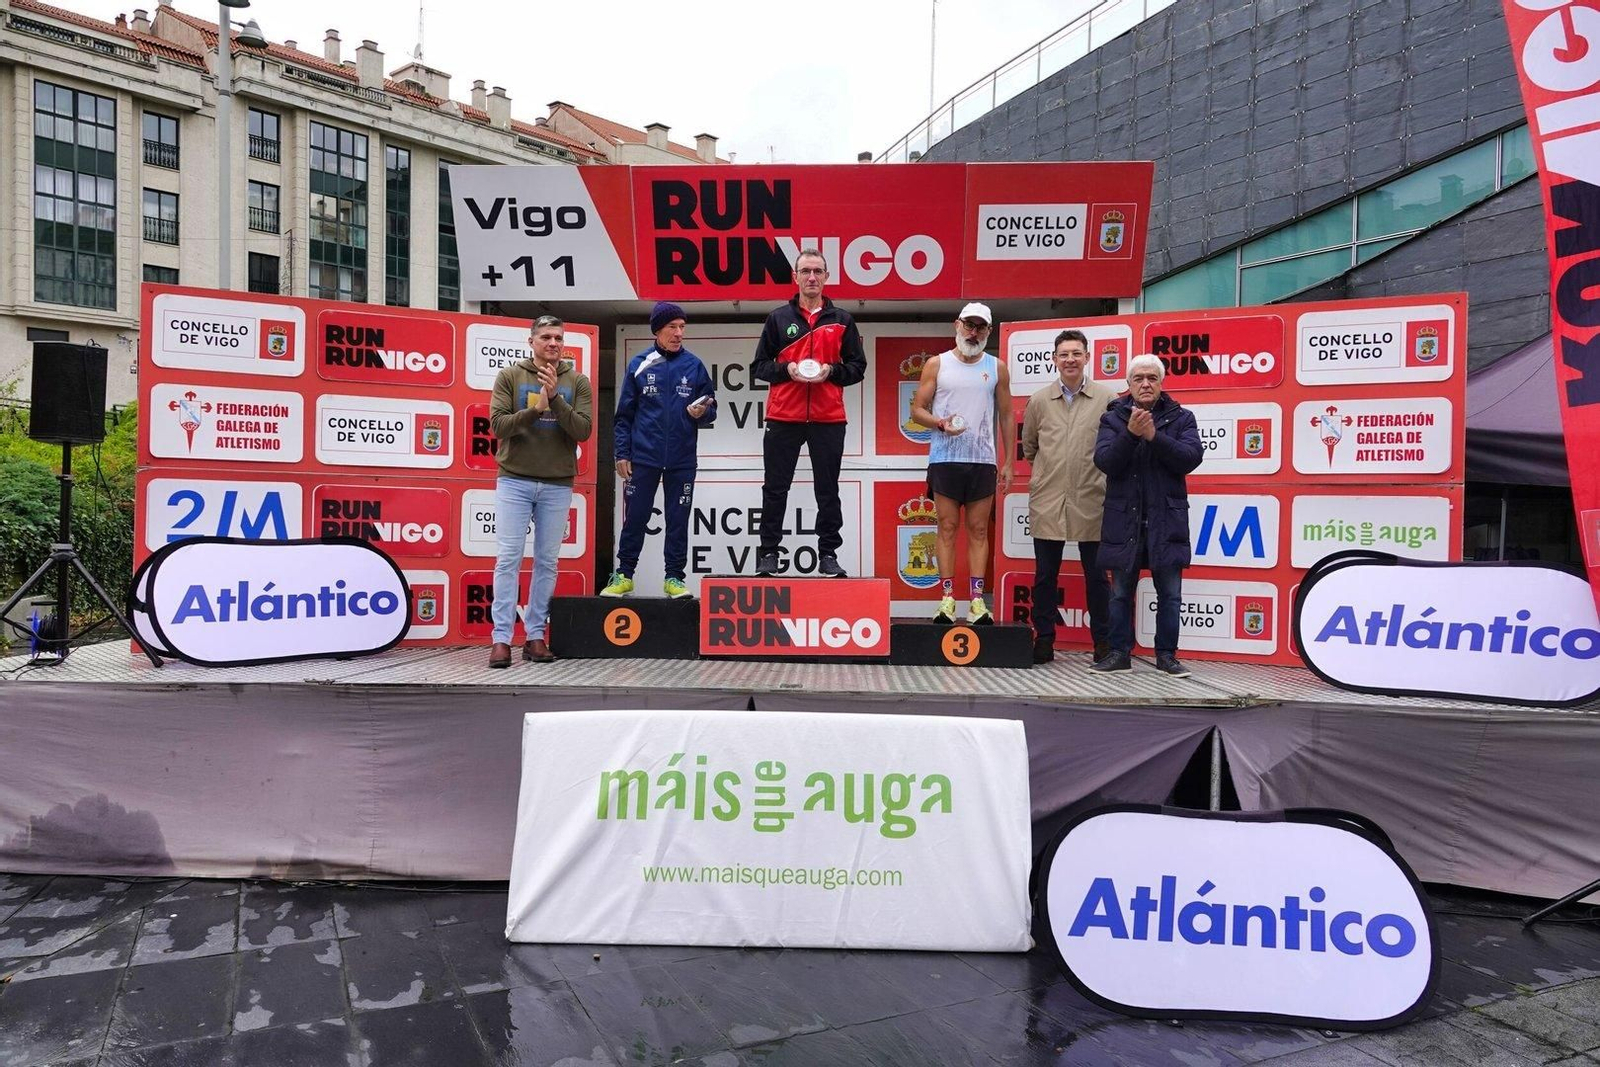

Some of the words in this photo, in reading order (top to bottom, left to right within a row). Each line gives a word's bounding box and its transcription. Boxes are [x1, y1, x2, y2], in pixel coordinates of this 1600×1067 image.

[652, 179, 791, 231] RUN
[463, 197, 586, 237] Vigo
[986, 215, 1077, 230] CONCELLO
[995, 234, 1018, 248] DE
[1024, 233, 1065, 248] VIGO
[482, 256, 575, 287] +11
[171, 319, 249, 336] CONCELLO
[180, 333, 199, 345] DE
[205, 335, 239, 348] VIGO
[325, 325, 384, 347] RUN
[1152, 333, 1209, 355] RUN
[1309, 332, 1393, 348] CONCELLO
[481, 346, 533, 359] CONCELL
[1017, 351, 1057, 363] CONC
[1319, 349, 1339, 361] DE
[1344, 347, 1383, 360] VIGO
[489, 359, 504, 369] DE
[1024, 364, 1041, 375] DE
[216, 403, 289, 418] FEDERACIÓN
[728, 402, 763, 429] VI
[216, 422, 261, 434] GALEGA
[265, 423, 279, 434] DE
[328, 417, 404, 432] CONCELLO
[1357, 412, 1434, 428] FEDERACIÓN
[215, 437, 281, 450] ATLETISMO
[337, 431, 356, 443] DE
[361, 432, 395, 444] VIGO
[1356, 433, 1402, 445] GALEGA
[1406, 433, 1422, 444] DE
[1355, 449, 1425, 462] ATLETISMO
[322, 500, 382, 520] RUN
[1303, 519, 1356, 543] máis
[1360, 521, 1373, 546] que
[1379, 524, 1437, 549] auga
[171, 580, 399, 625] Atlántico
[709, 586, 791, 615] RUN
[1149, 601, 1224, 615] CCELLO
[615, 615, 630, 638] 2
[1181, 616, 1215, 628] VIGO
[1314, 604, 1600, 659] Atlántico
[952, 633, 969, 658] 3
[597, 753, 741, 821] máis
[752, 760, 794, 832] que
[803, 772, 952, 839] auga
[643, 863, 902, 890] www.maisqueauga.com
[1068, 875, 1416, 958] Atlántico
